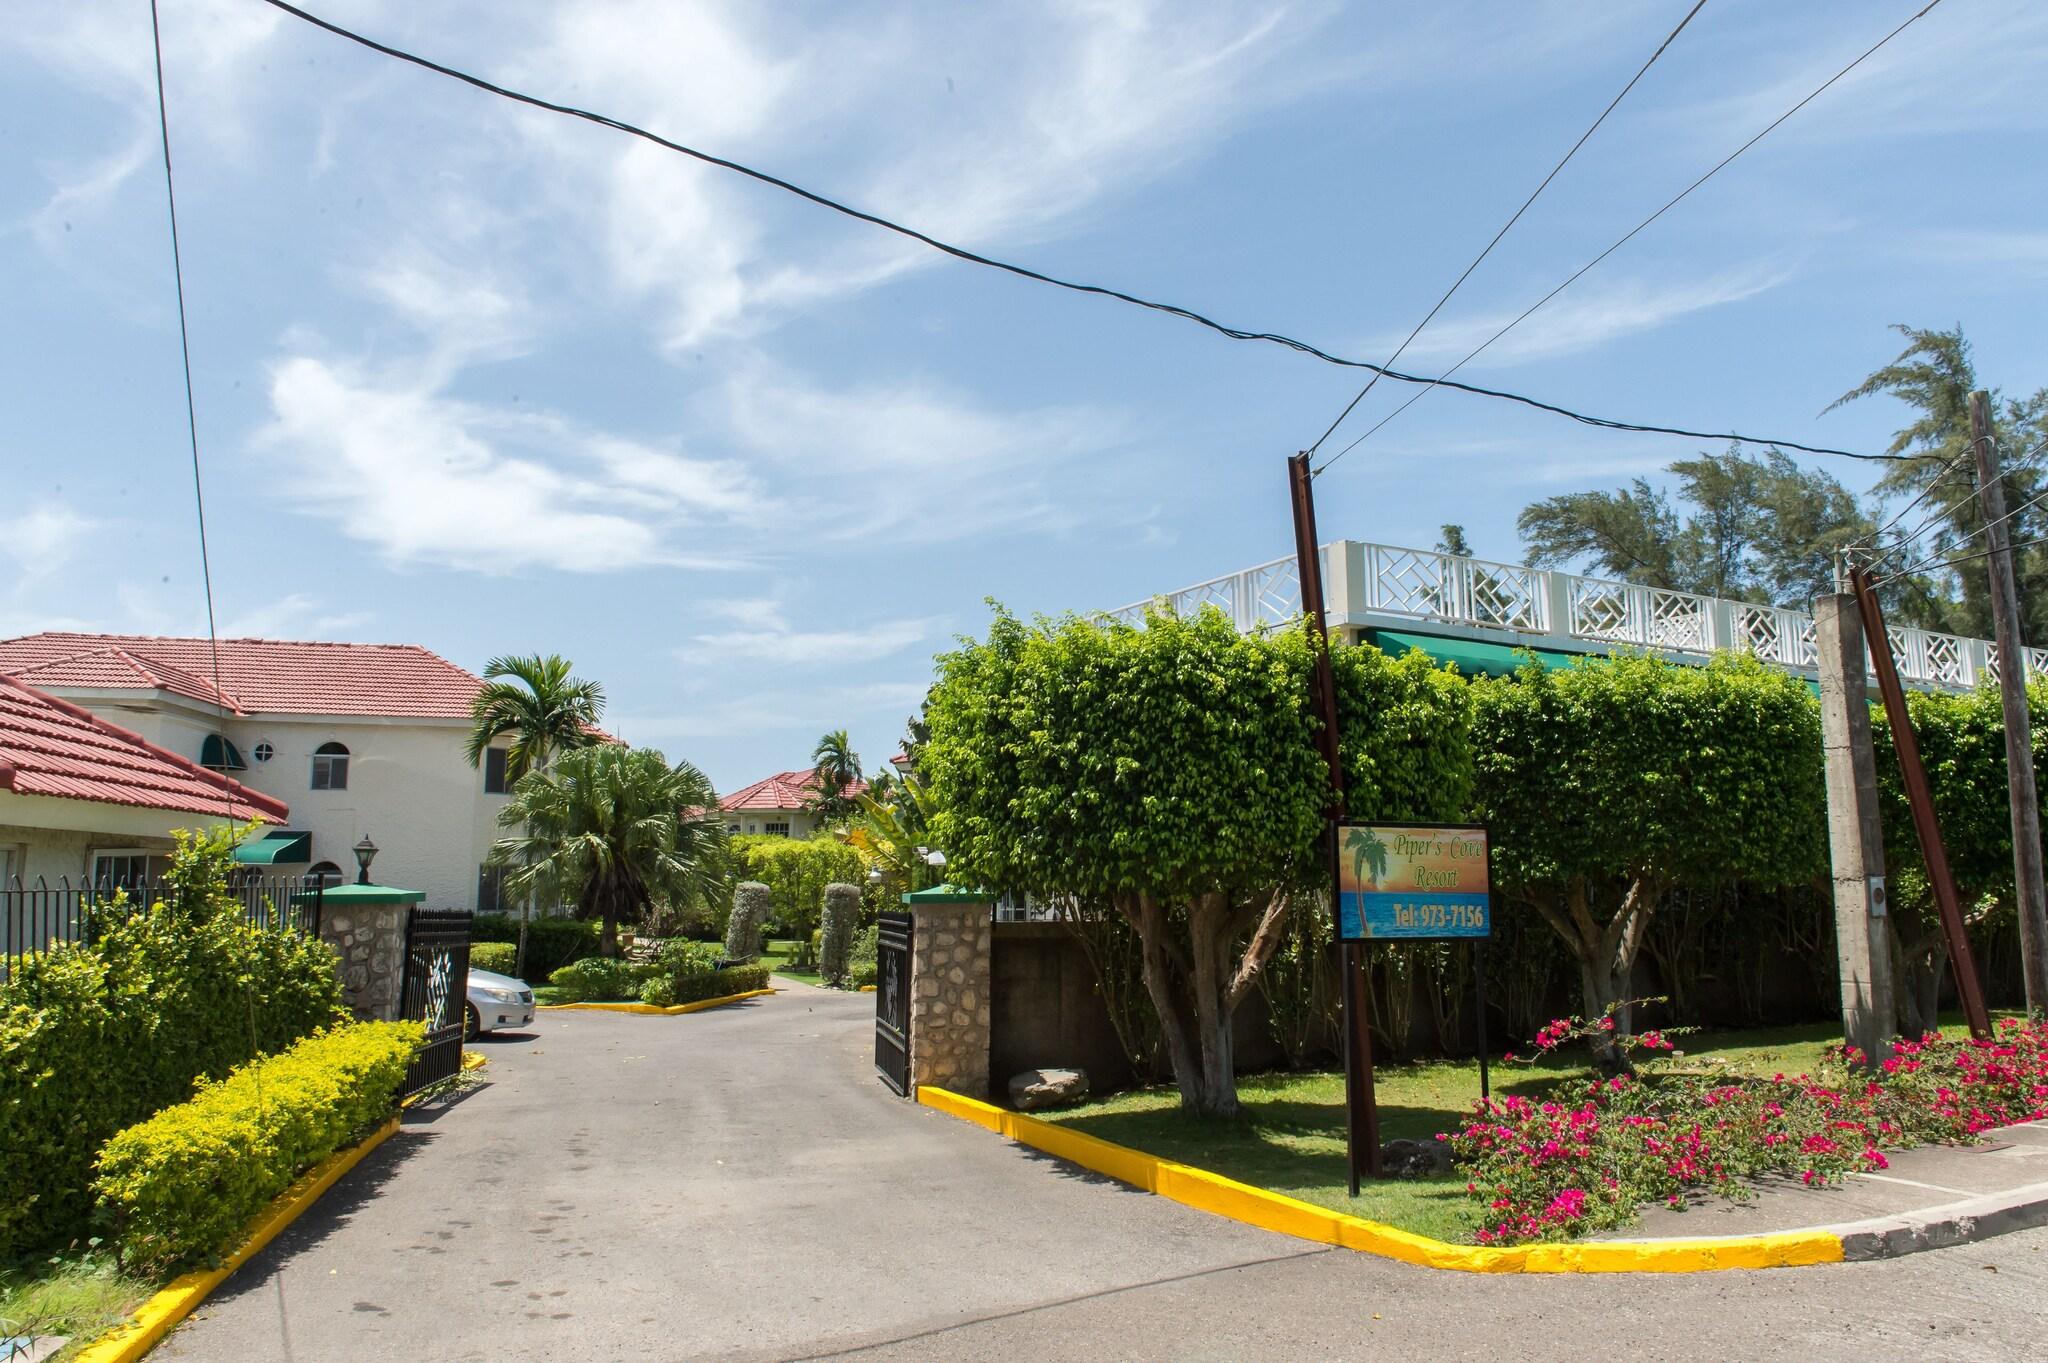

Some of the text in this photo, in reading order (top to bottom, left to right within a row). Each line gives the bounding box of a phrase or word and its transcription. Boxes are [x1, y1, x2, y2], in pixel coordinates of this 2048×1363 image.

[1394, 832, 1482, 863] Piper's Cove
[1415, 865, 1458, 892] Resort
[1393, 904, 1484, 928] Tel: 973-7156
